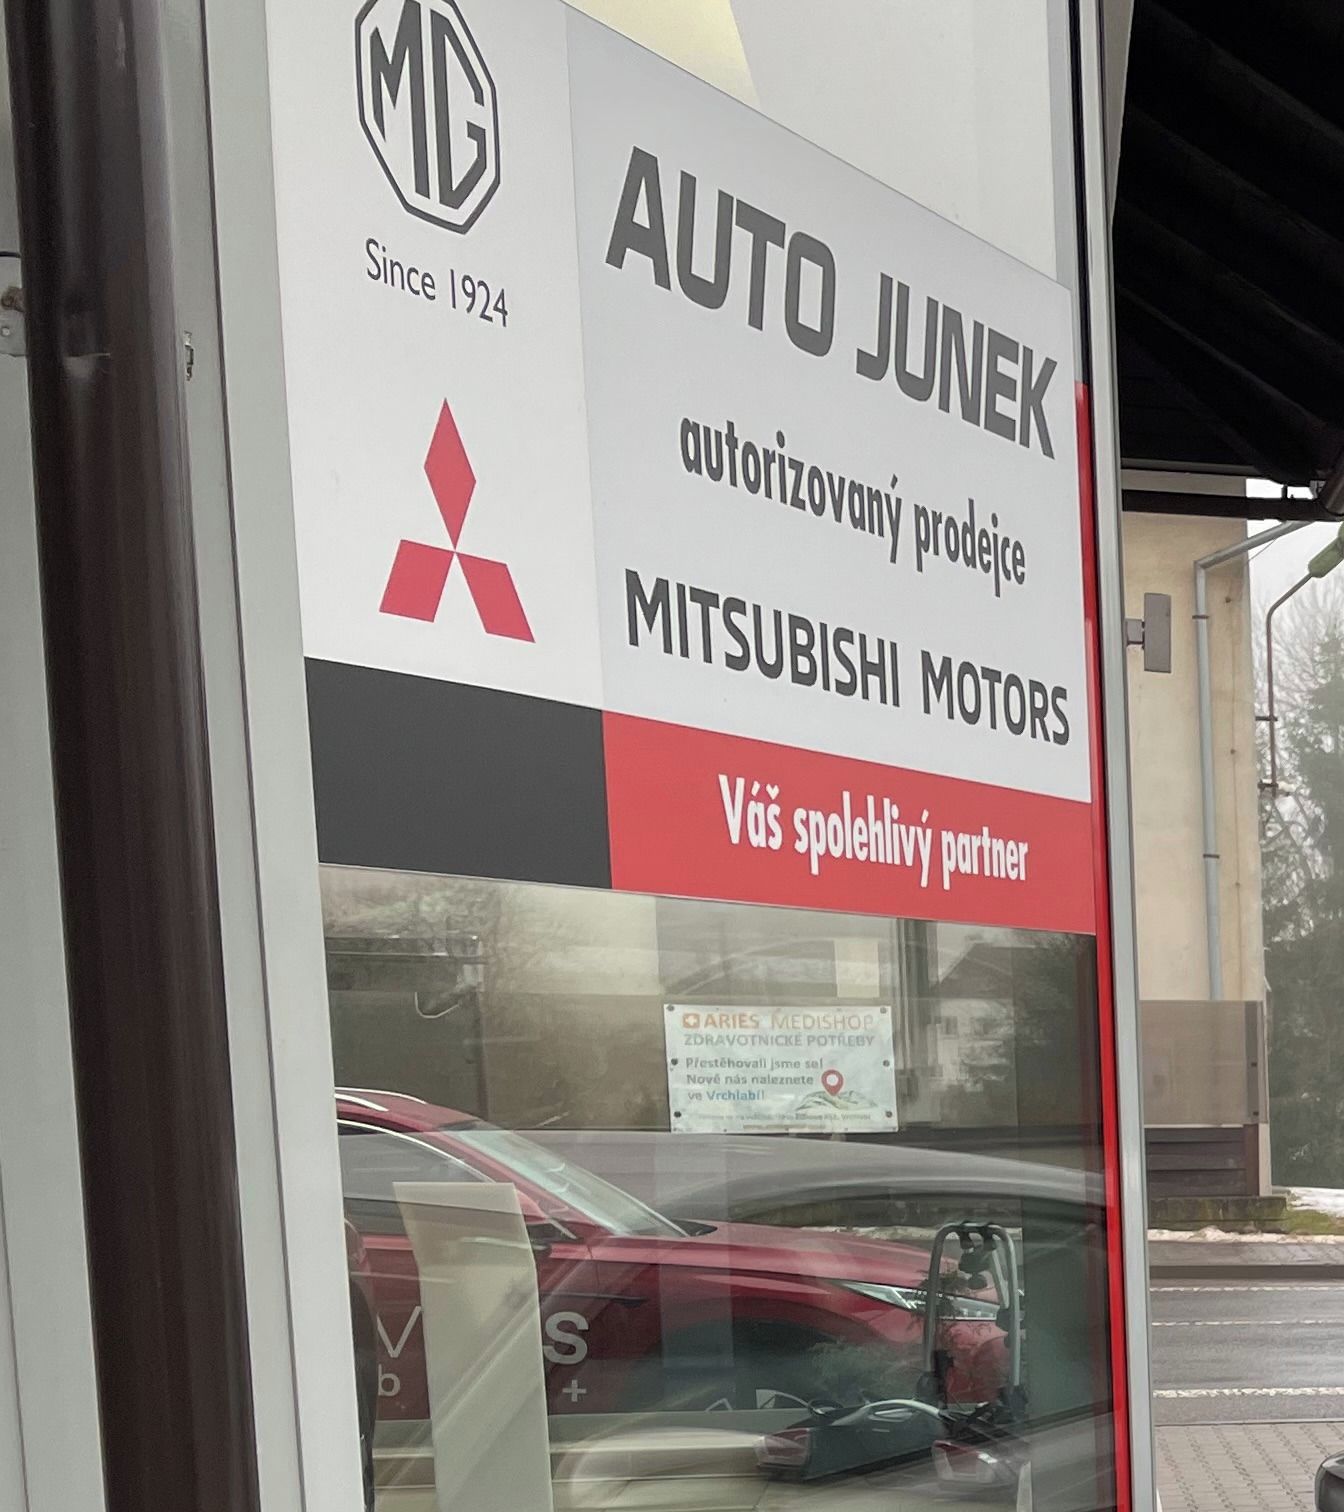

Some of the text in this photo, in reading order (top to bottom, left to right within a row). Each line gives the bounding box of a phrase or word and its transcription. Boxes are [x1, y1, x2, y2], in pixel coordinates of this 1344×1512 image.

[368, 0, 488, 211] MG
[364, 237, 510, 328] Since 1924
[605, 145, 1058, 460] AUTO JUNEK
[679, 415, 1026, 598] autorizovaný prodejce
[625, 568, 1071, 746] MITSUBISHI MOTORS
[718, 774, 1029, 891] Váš spolehlivý partner
[704, 1013, 876, 1030] ARIES MEDISHOP
[770, 1057, 801, 1071] jsme
[688, 1092, 703, 1101] ve
[725, 1073, 748, 1085] nás
[751, 1074, 814, 1086] naleznete
